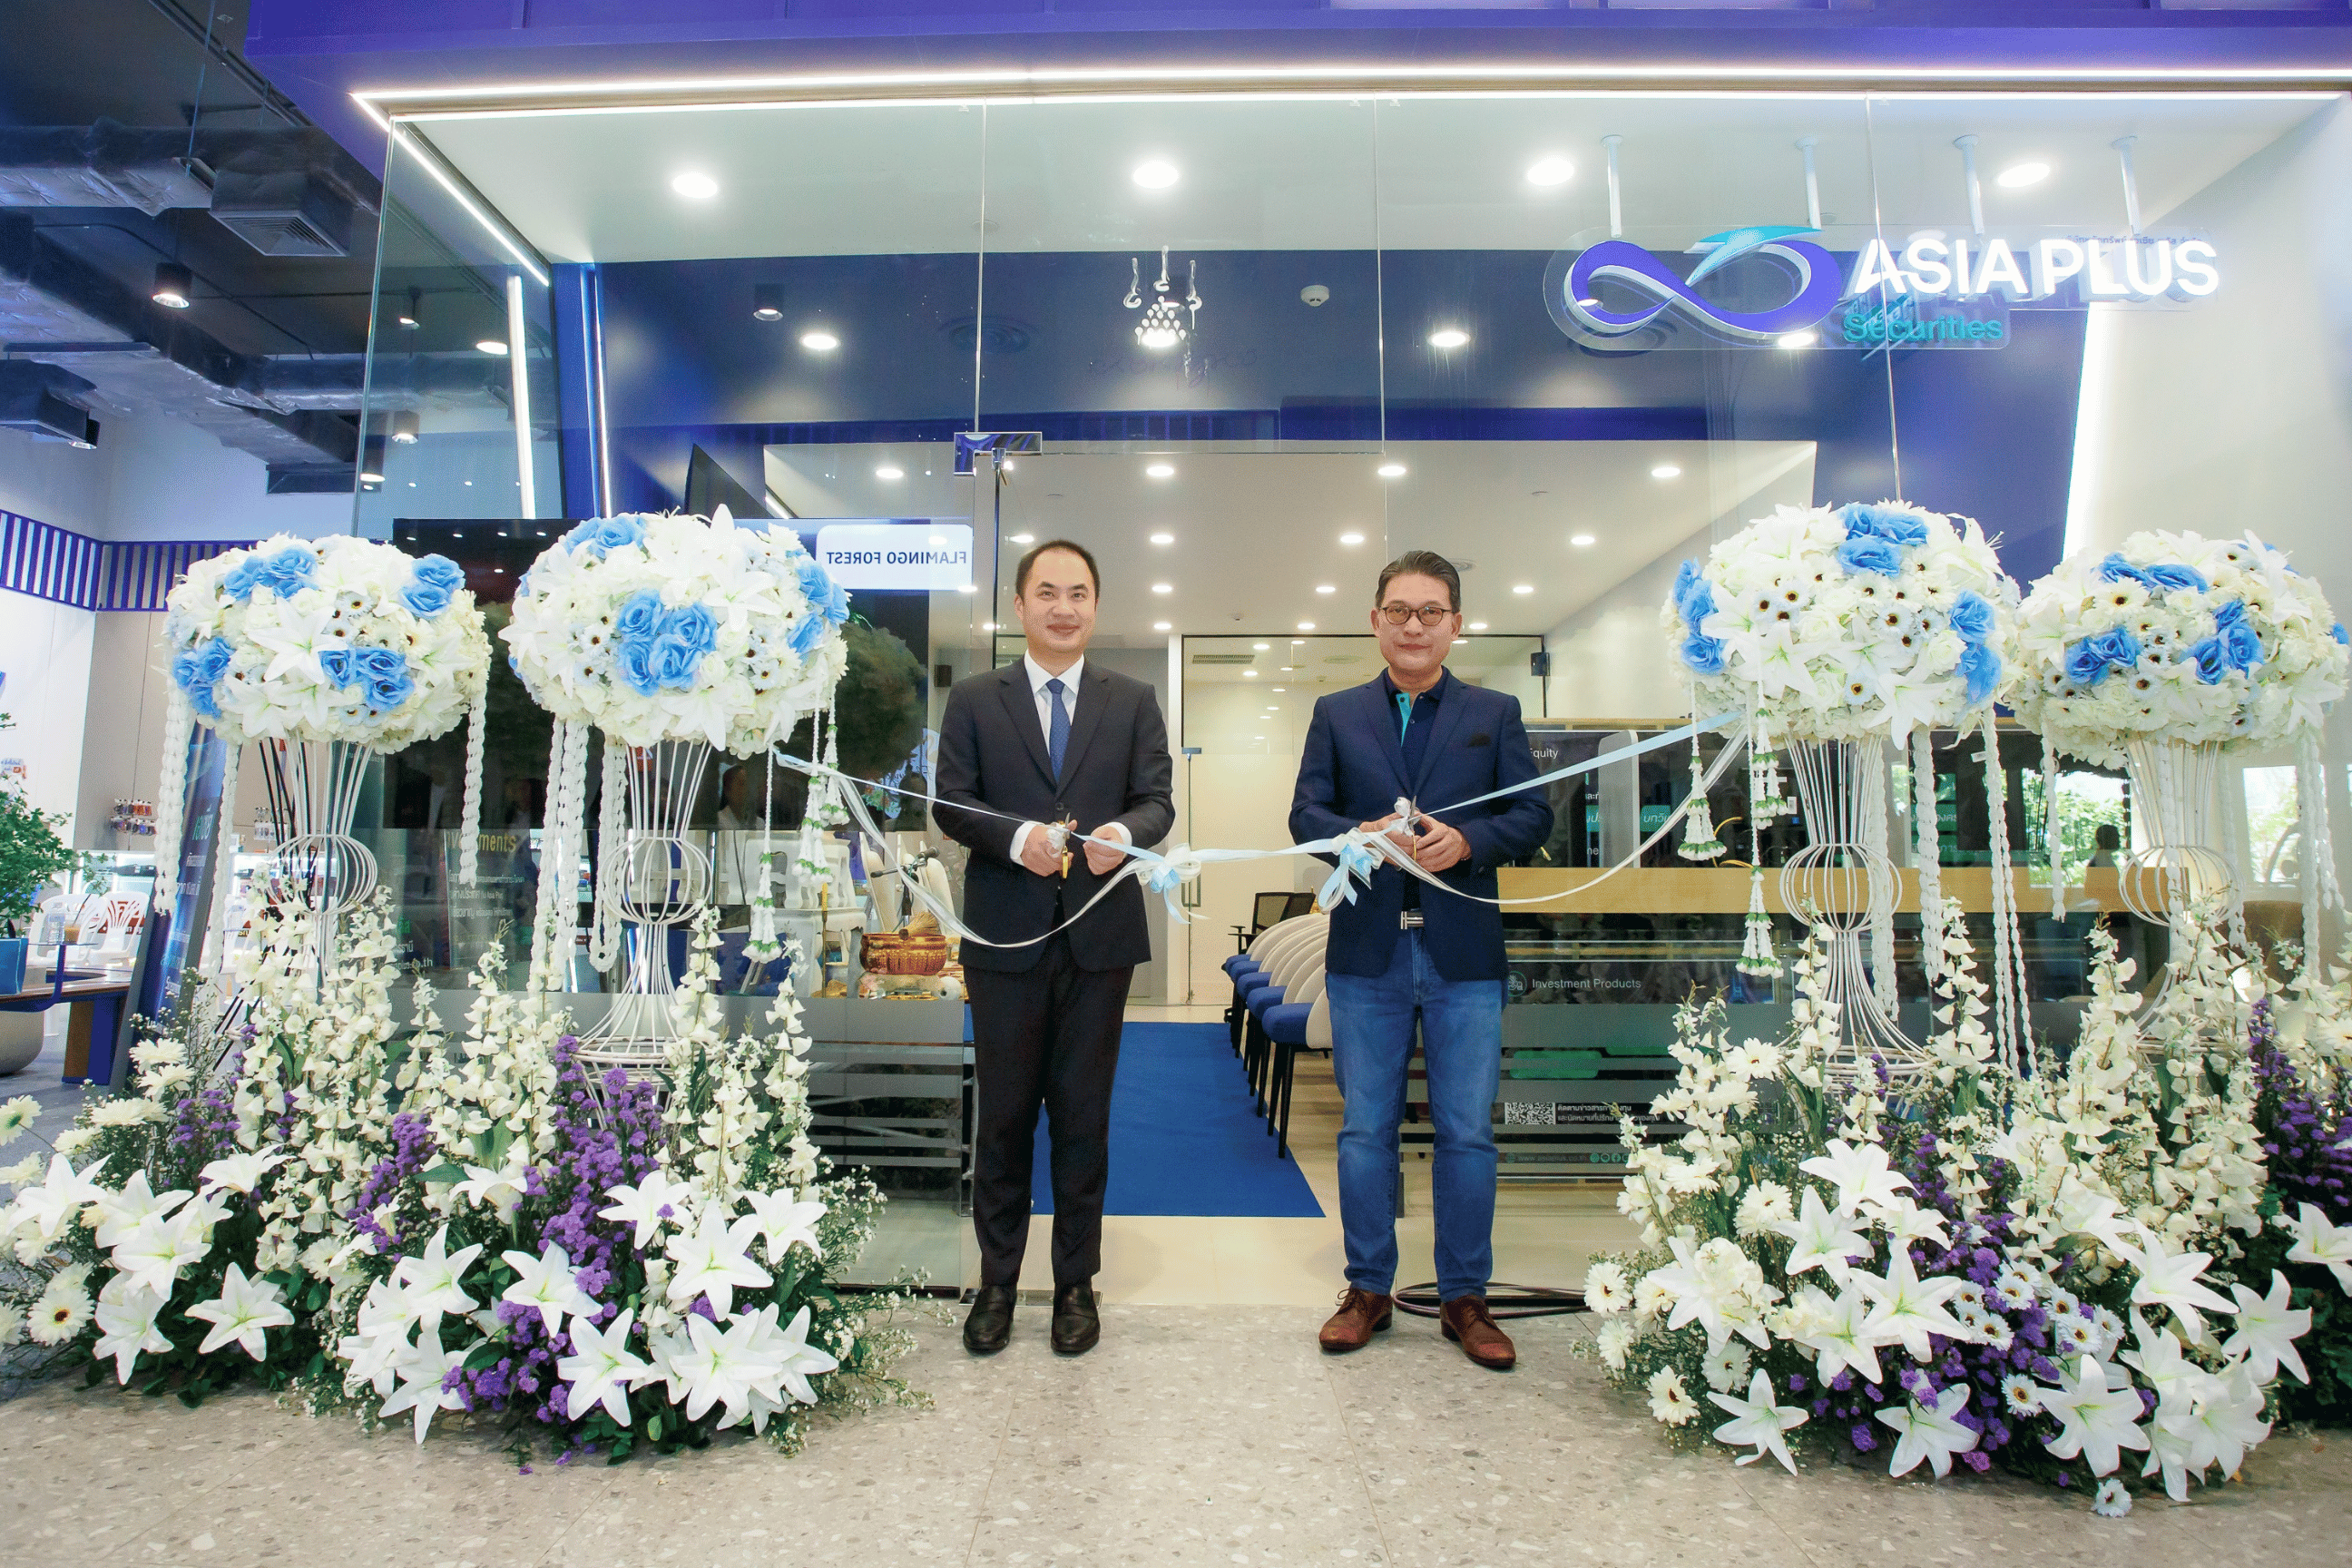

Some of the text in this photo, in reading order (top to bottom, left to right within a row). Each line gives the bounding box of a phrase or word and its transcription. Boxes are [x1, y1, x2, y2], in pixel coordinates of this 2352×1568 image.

[1854, 238, 2220, 296] ASIA PLUS
[1843, 313, 2004, 343] Securities
[1532, 978, 1642, 989] Investment Products
